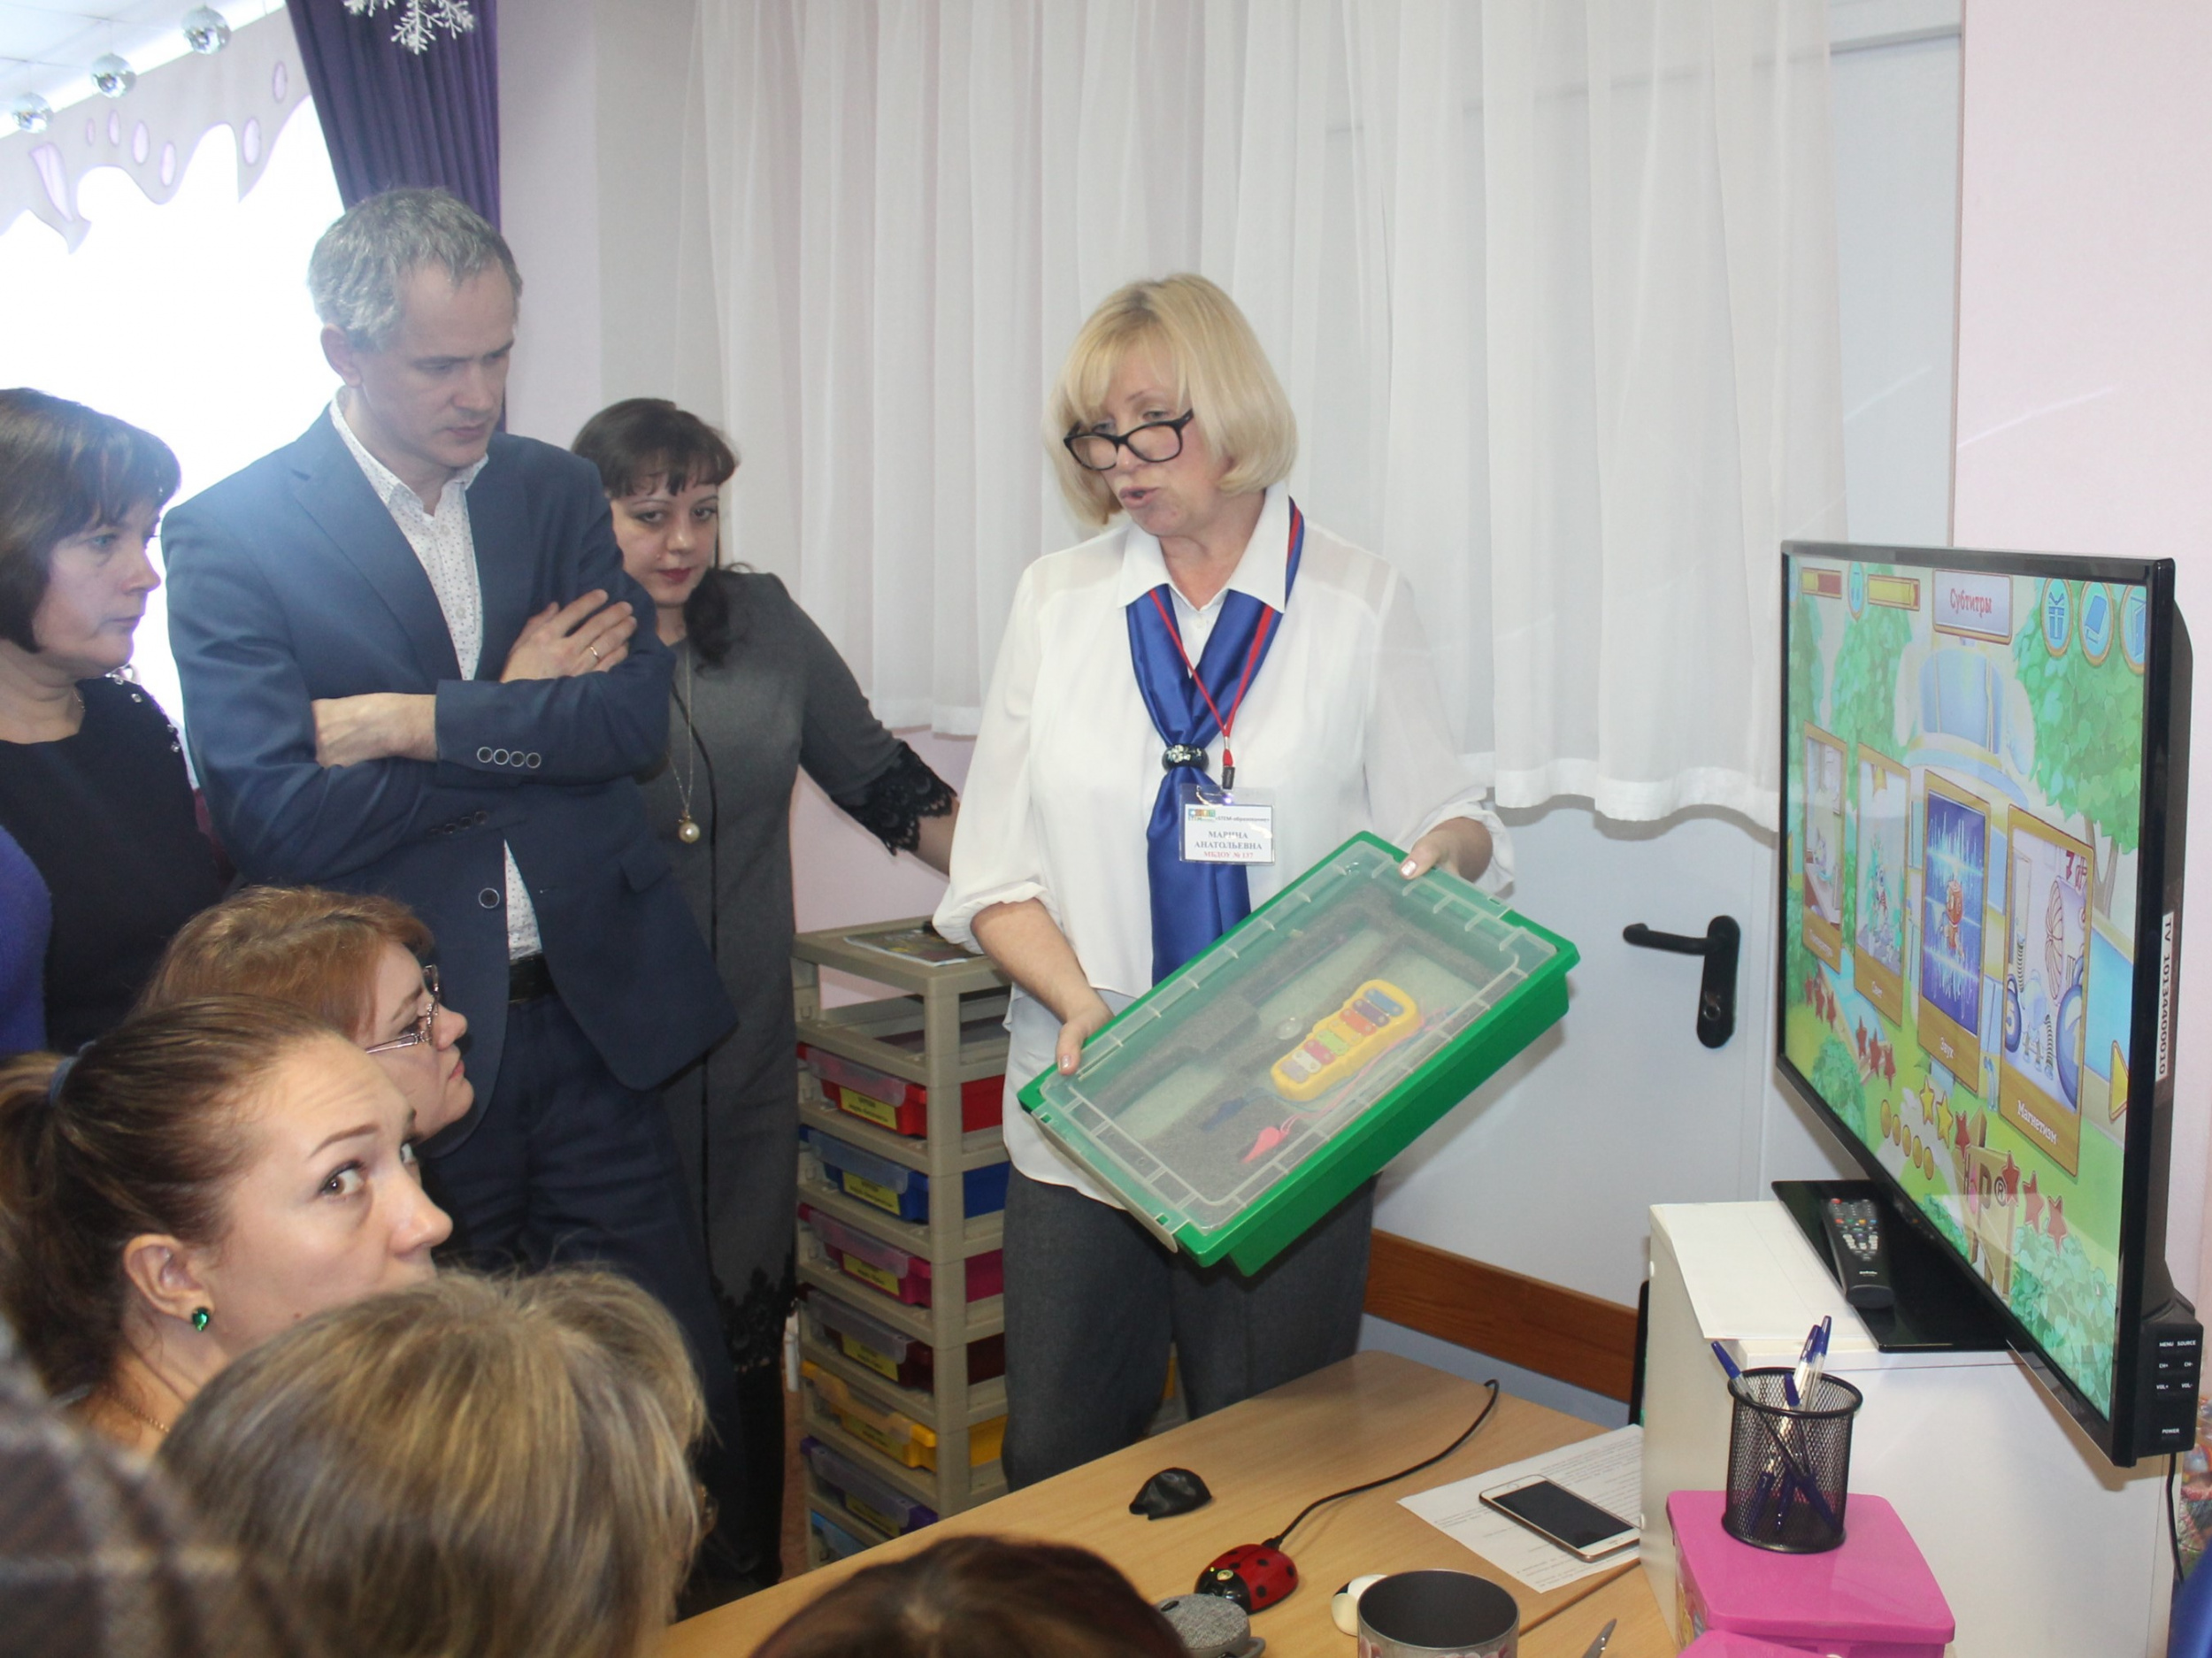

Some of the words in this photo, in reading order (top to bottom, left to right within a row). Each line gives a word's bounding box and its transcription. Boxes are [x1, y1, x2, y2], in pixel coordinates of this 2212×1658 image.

[1949, 587, 1993, 618] Субтитры
[1194, 841, 1263, 850] АНАТОЛЬЕВНА
[1208, 831, 1248, 840] МАРИНА
[2164, 917, 2172, 941] TV
[2159, 954, 2170, 1075] 10134400010
[2017, 1100, 2058, 1145] Магнетизм
